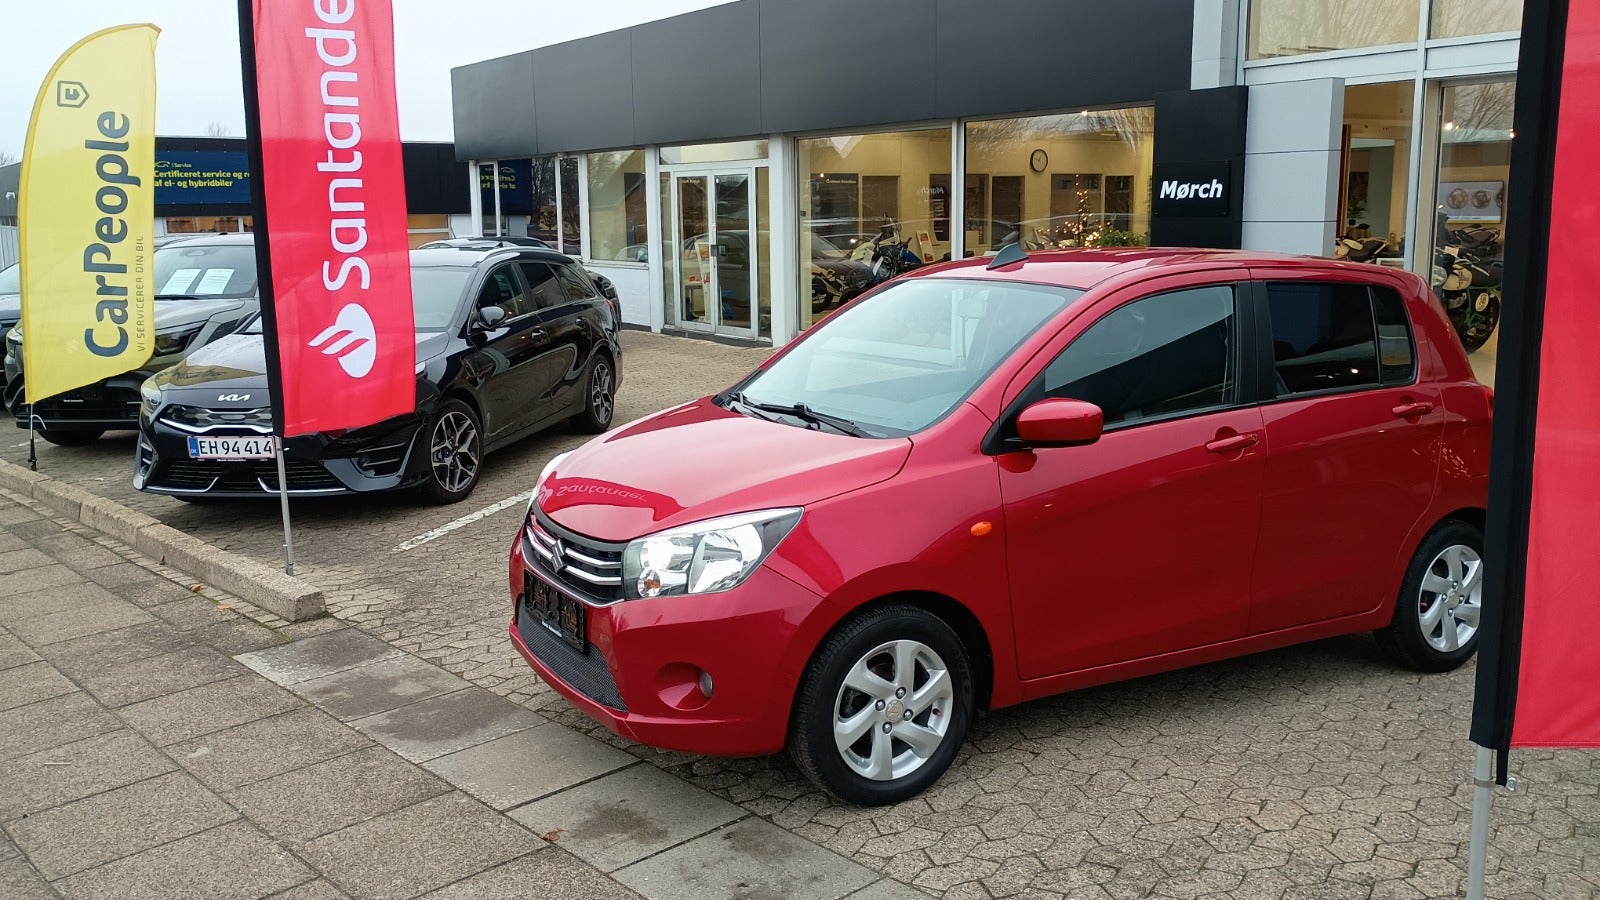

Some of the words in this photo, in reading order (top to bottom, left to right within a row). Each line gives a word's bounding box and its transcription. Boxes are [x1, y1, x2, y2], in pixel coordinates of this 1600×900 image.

[154, 170, 201, 178] Certificeret
[232, 172, 243, 180] og
[154, 179, 162, 187] af
[164, 179, 175, 187] el-
[189, 179, 233, 188] hybridbiler
[1159, 178, 1223, 200] Mørch
[84, 111, 141, 357] CarPeople
[135, 236, 144, 252] BIL
[135, 255, 144, 273] DIN
[136, 276, 145, 338] SERVICERER
[136, 342, 145, 352] VI
[199, 440, 219, 455] EH
[221, 441, 240, 455] 94
[244, 440, 272, 455] 414
